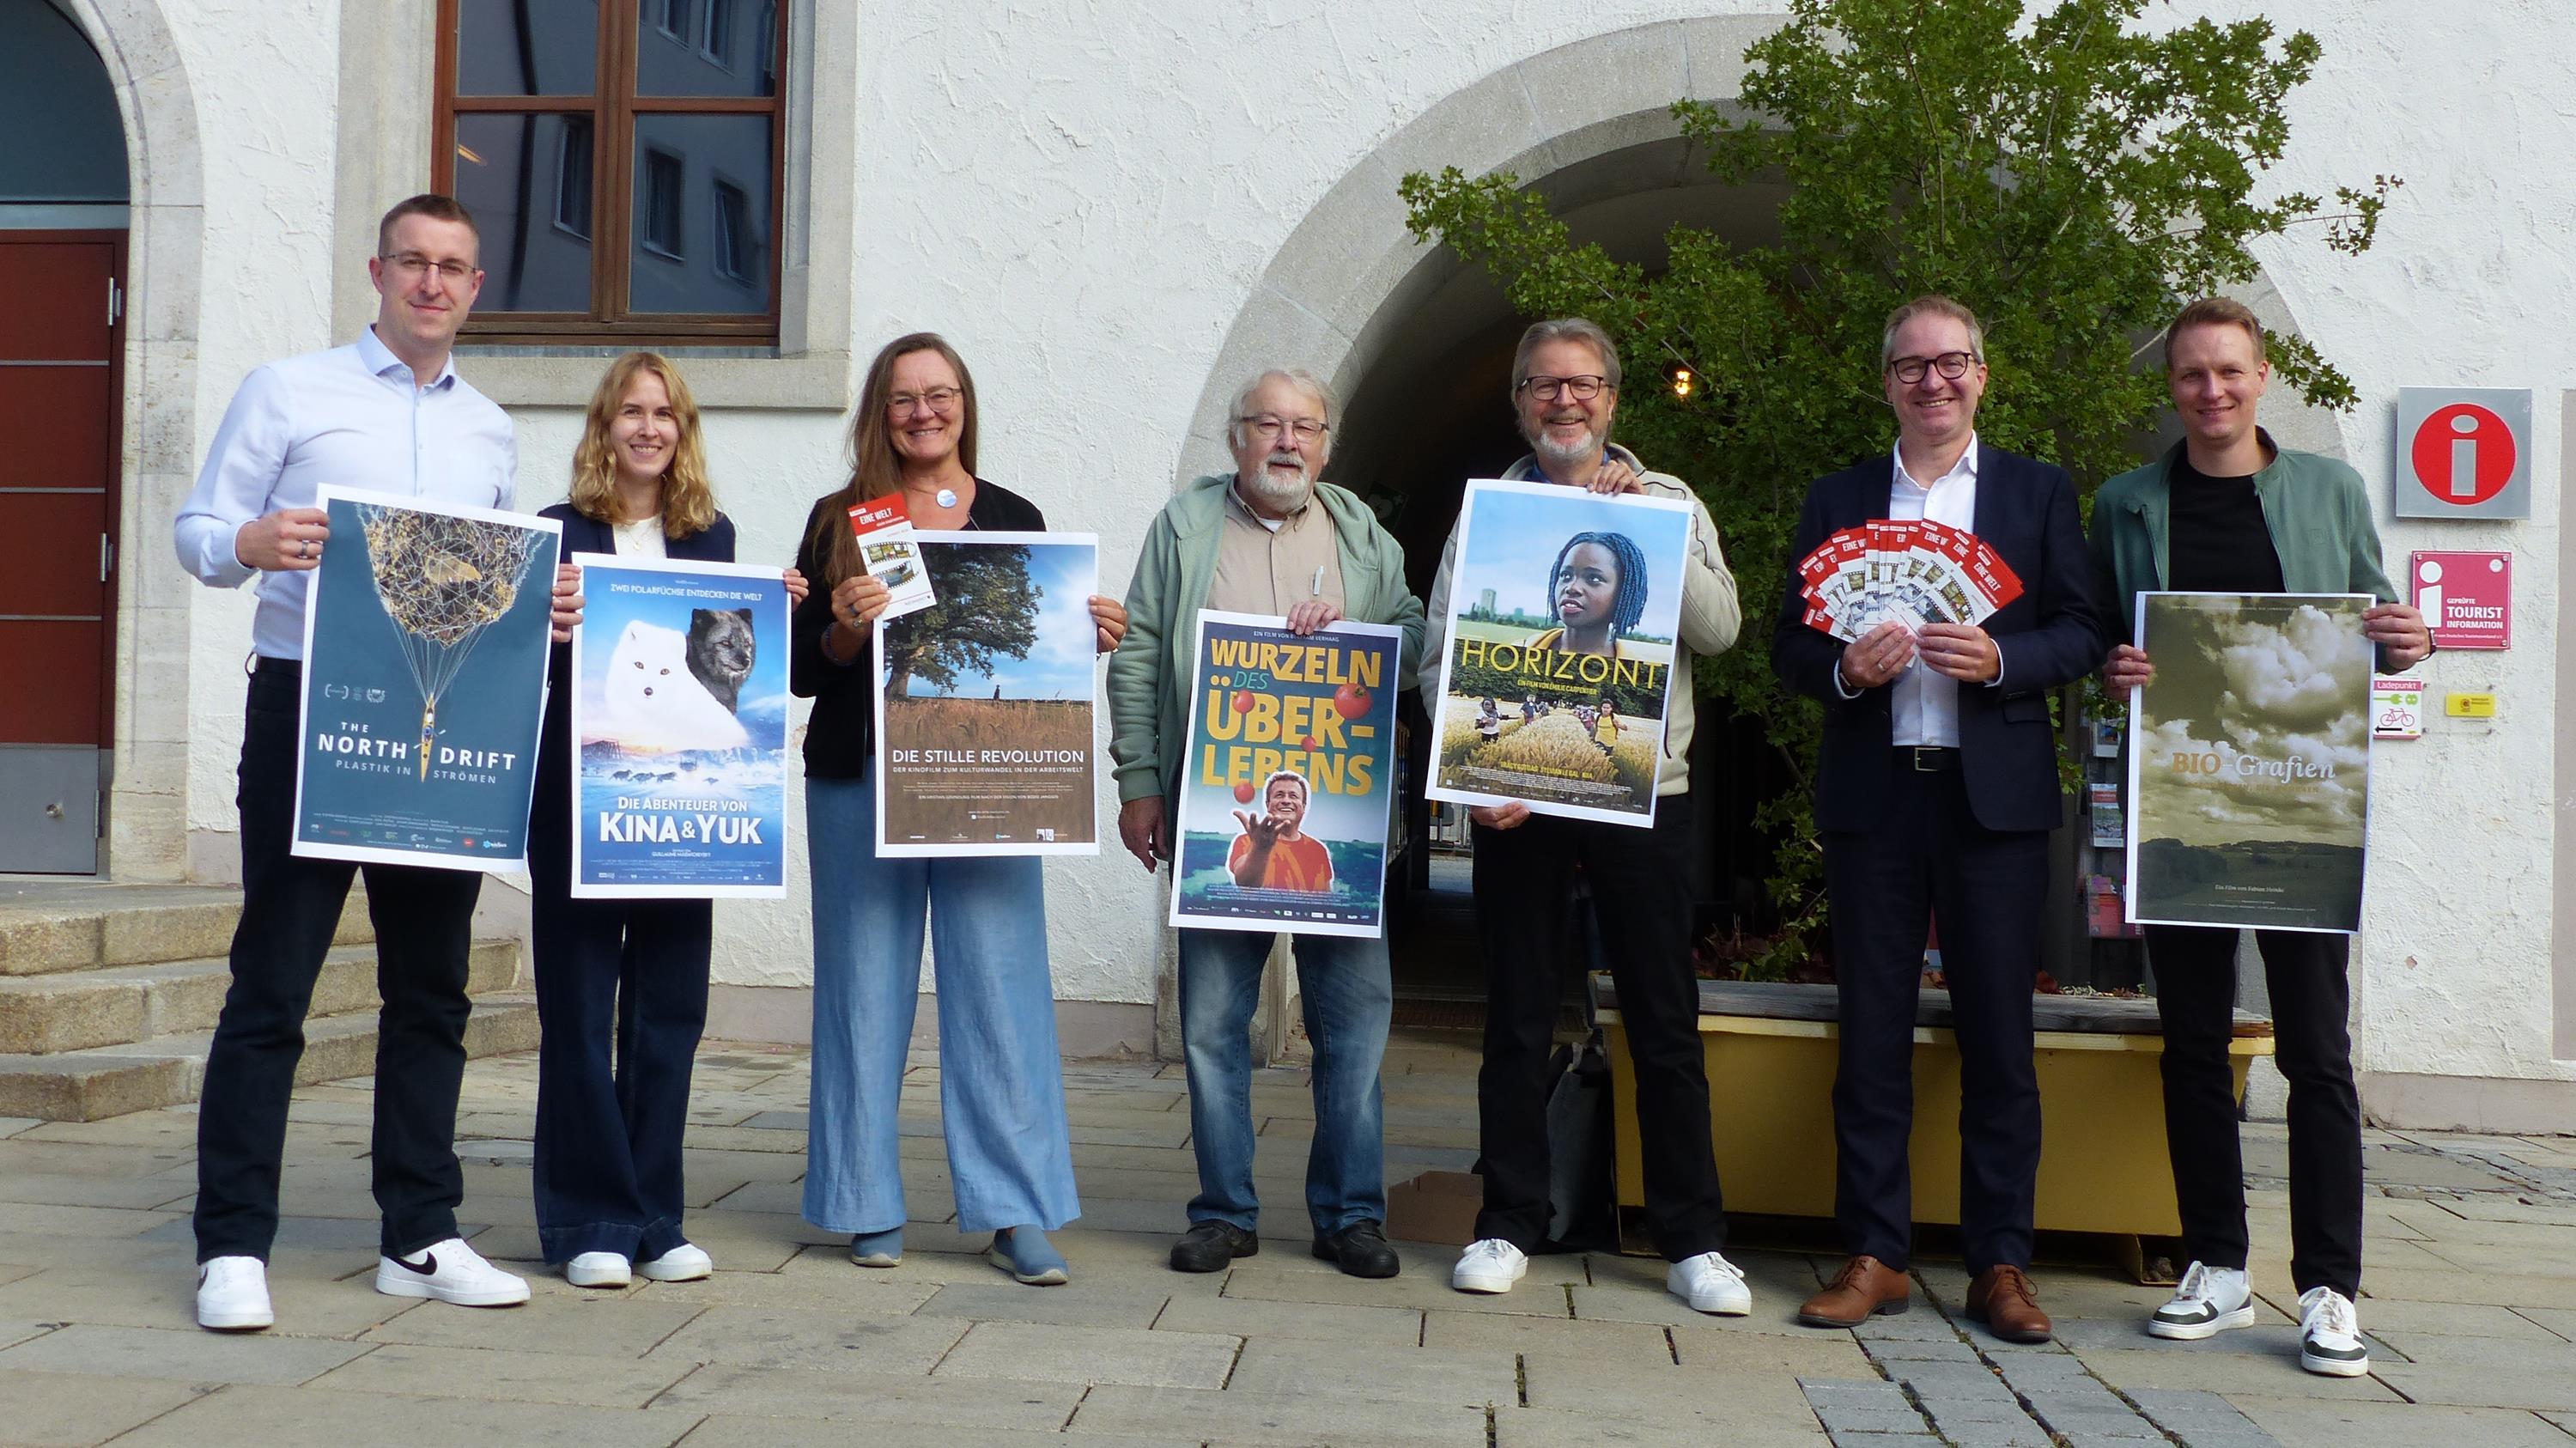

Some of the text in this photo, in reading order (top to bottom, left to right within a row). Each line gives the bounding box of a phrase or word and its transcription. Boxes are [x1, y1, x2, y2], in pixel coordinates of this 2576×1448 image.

[859, 514, 876, 525] EINE
[874, 508, 893, 520] WELT
[1842, 540, 1858, 551] EINE
[1923, 532, 1941, 544] EINE
[1953, 543, 1970, 557] EINE
[1973, 562, 1989, 578] EINE
[1984, 574, 2002, 591] WELT
[611, 583, 629, 593] ZWEI
[631, 585, 685, 597] POLARFÜCHSE
[687, 588, 729, 599] ENTDECKEN
[743, 593, 762, 601] WELT
[2446, 606, 2503, 618] TOURIST
[1211, 638, 1382, 688] WURZELN
[1461, 637, 1662, 690] HORIZONT
[1233, 671, 1269, 690] DES
[2377, 681, 2416, 691] Ladepunkt
[341, 721, 369, 733] THE
[318, 733, 516, 770] NORTH DRIFT
[892, 750, 1084, 764] DIE STILLE REVOLUTION
[336, 759, 496, 783] PLASTIK IN STRÖMEN
[617, 796, 748, 812] DIE ABENTEUER VON
